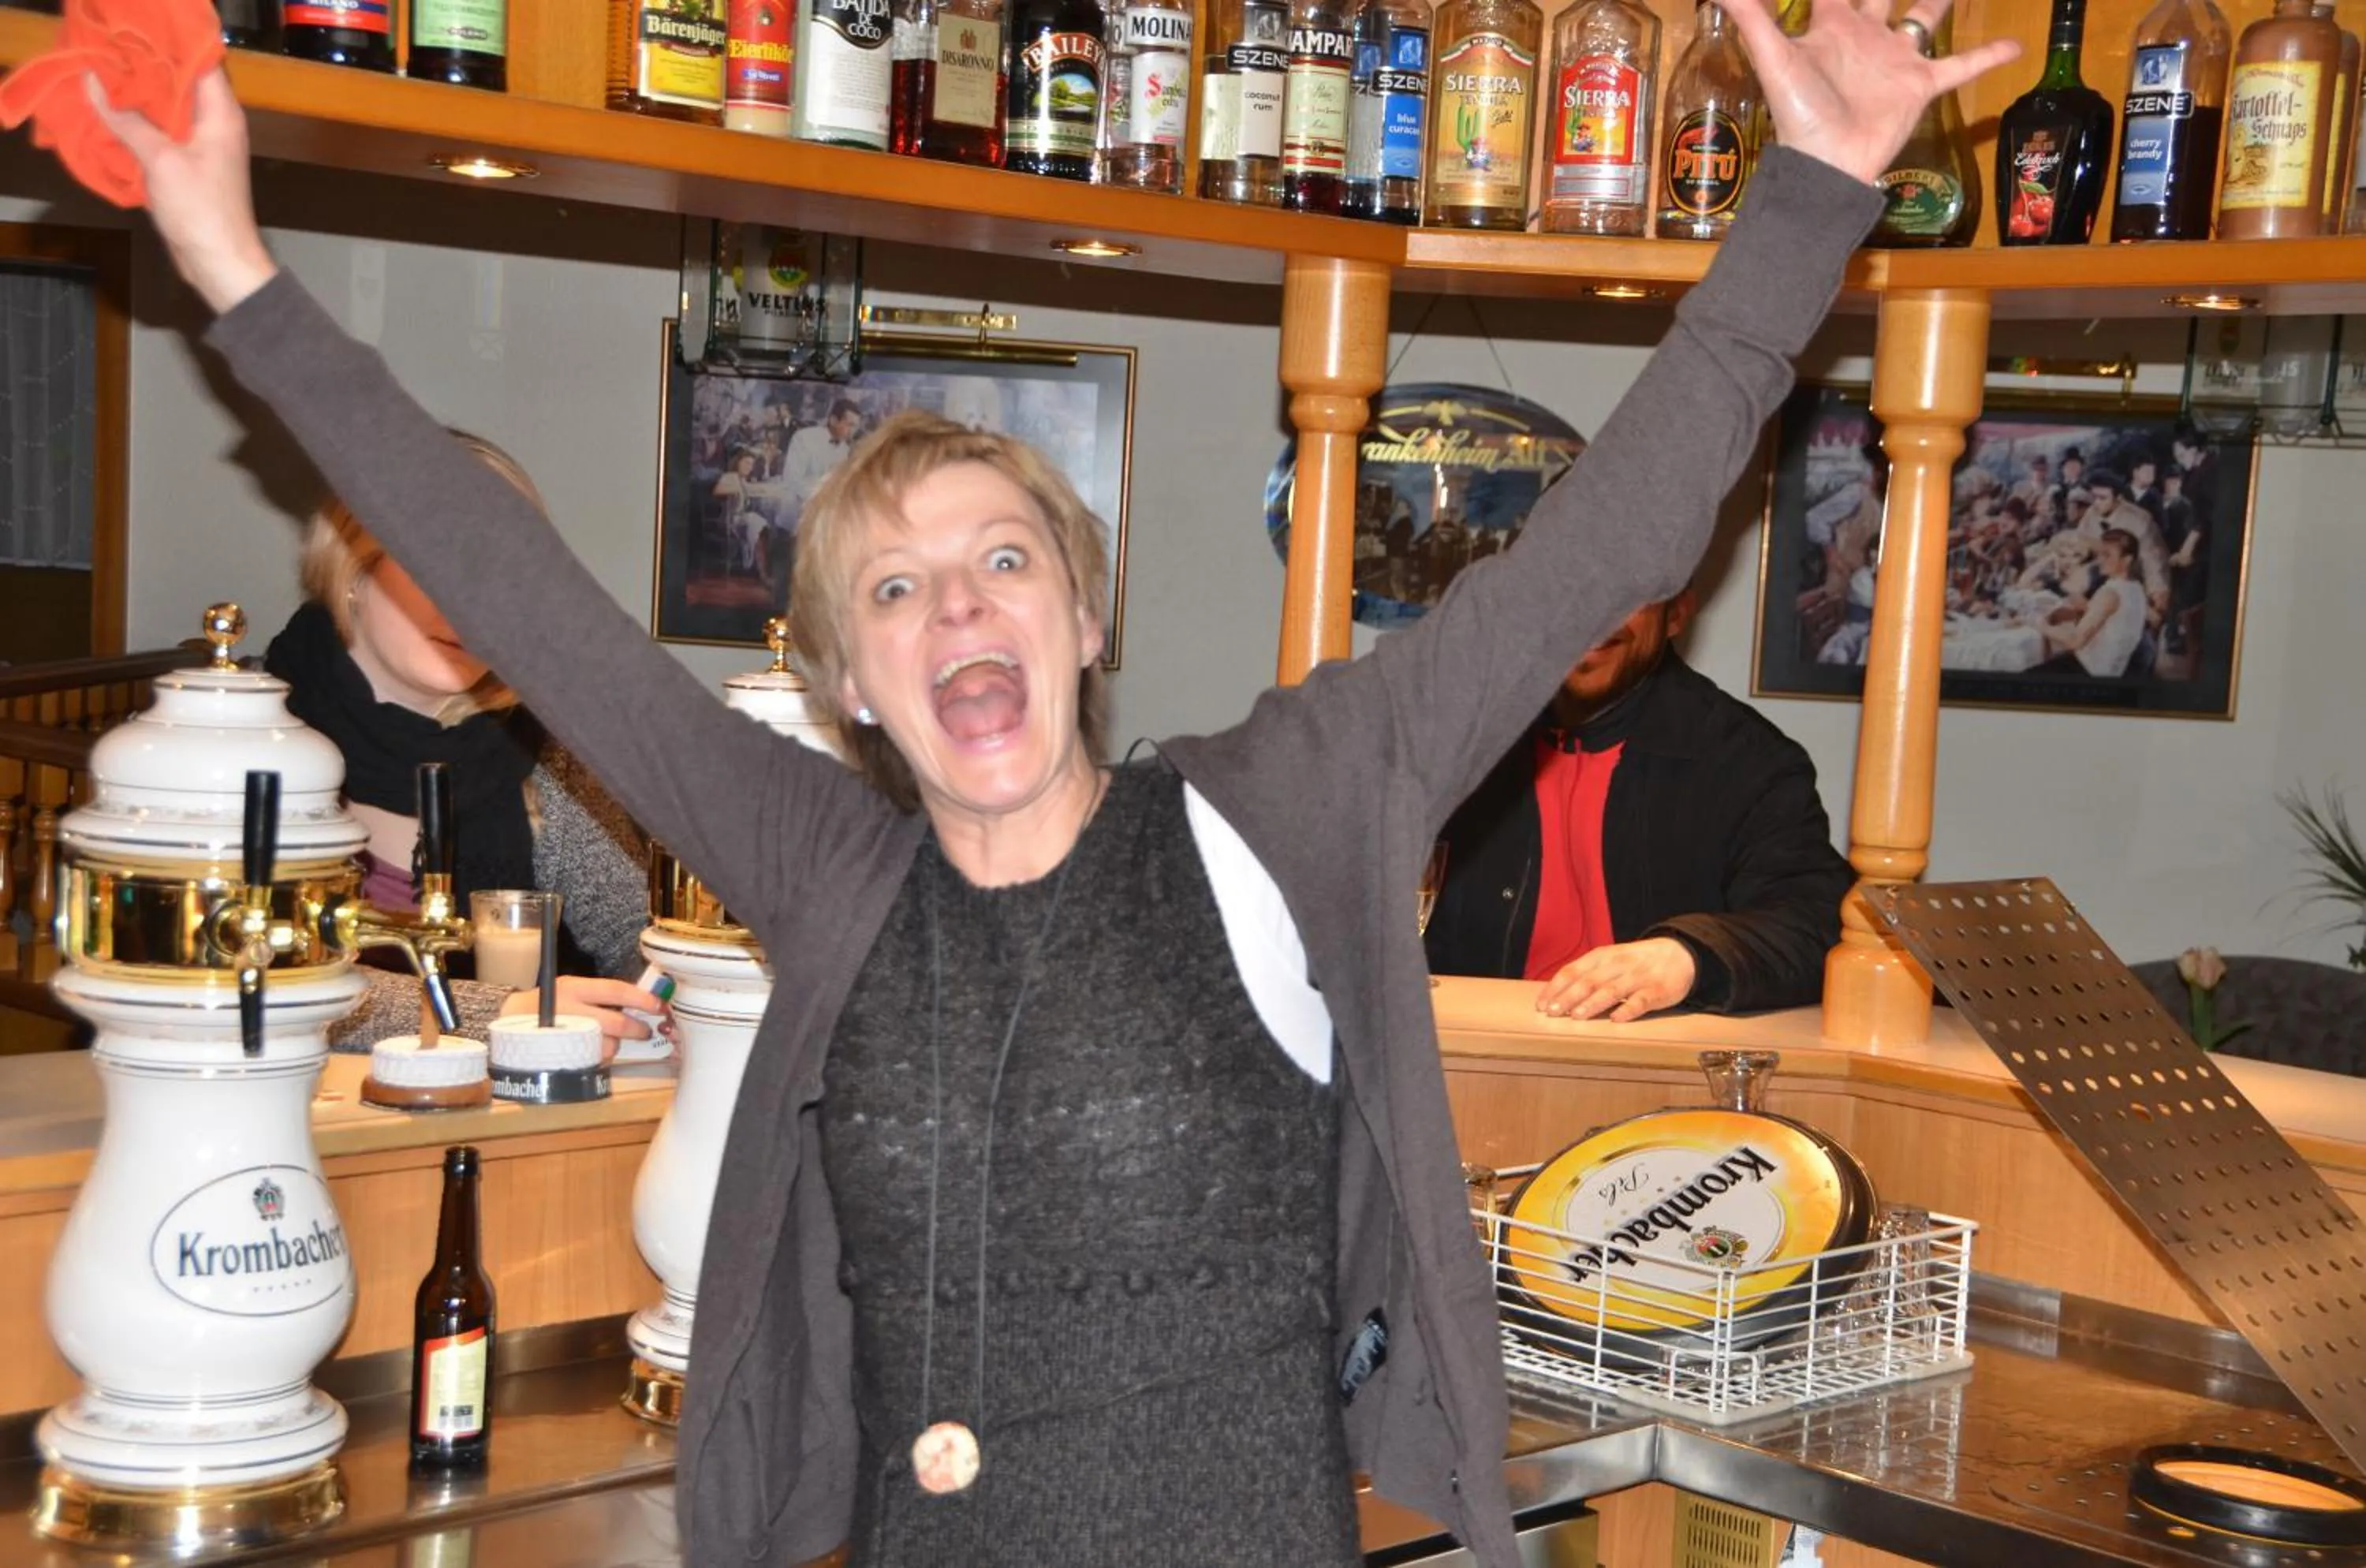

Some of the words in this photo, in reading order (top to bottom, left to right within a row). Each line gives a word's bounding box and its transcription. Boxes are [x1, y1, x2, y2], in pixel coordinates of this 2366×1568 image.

[848, 23, 881, 39] COCO
[1289, 30, 1354, 59] AMPAR
[942, 50, 995, 73] DISARONNO
[1446, 71, 1524, 93] SIERRA
[1564, 84, 1632, 109] SIERRA
[2125, 95, 2185, 114] SZENE
[1361, 427, 1498, 473] rankenheim
[1559, 1146, 1778, 1283] Krombacher
[177, 1219, 347, 1277] Krombacher
